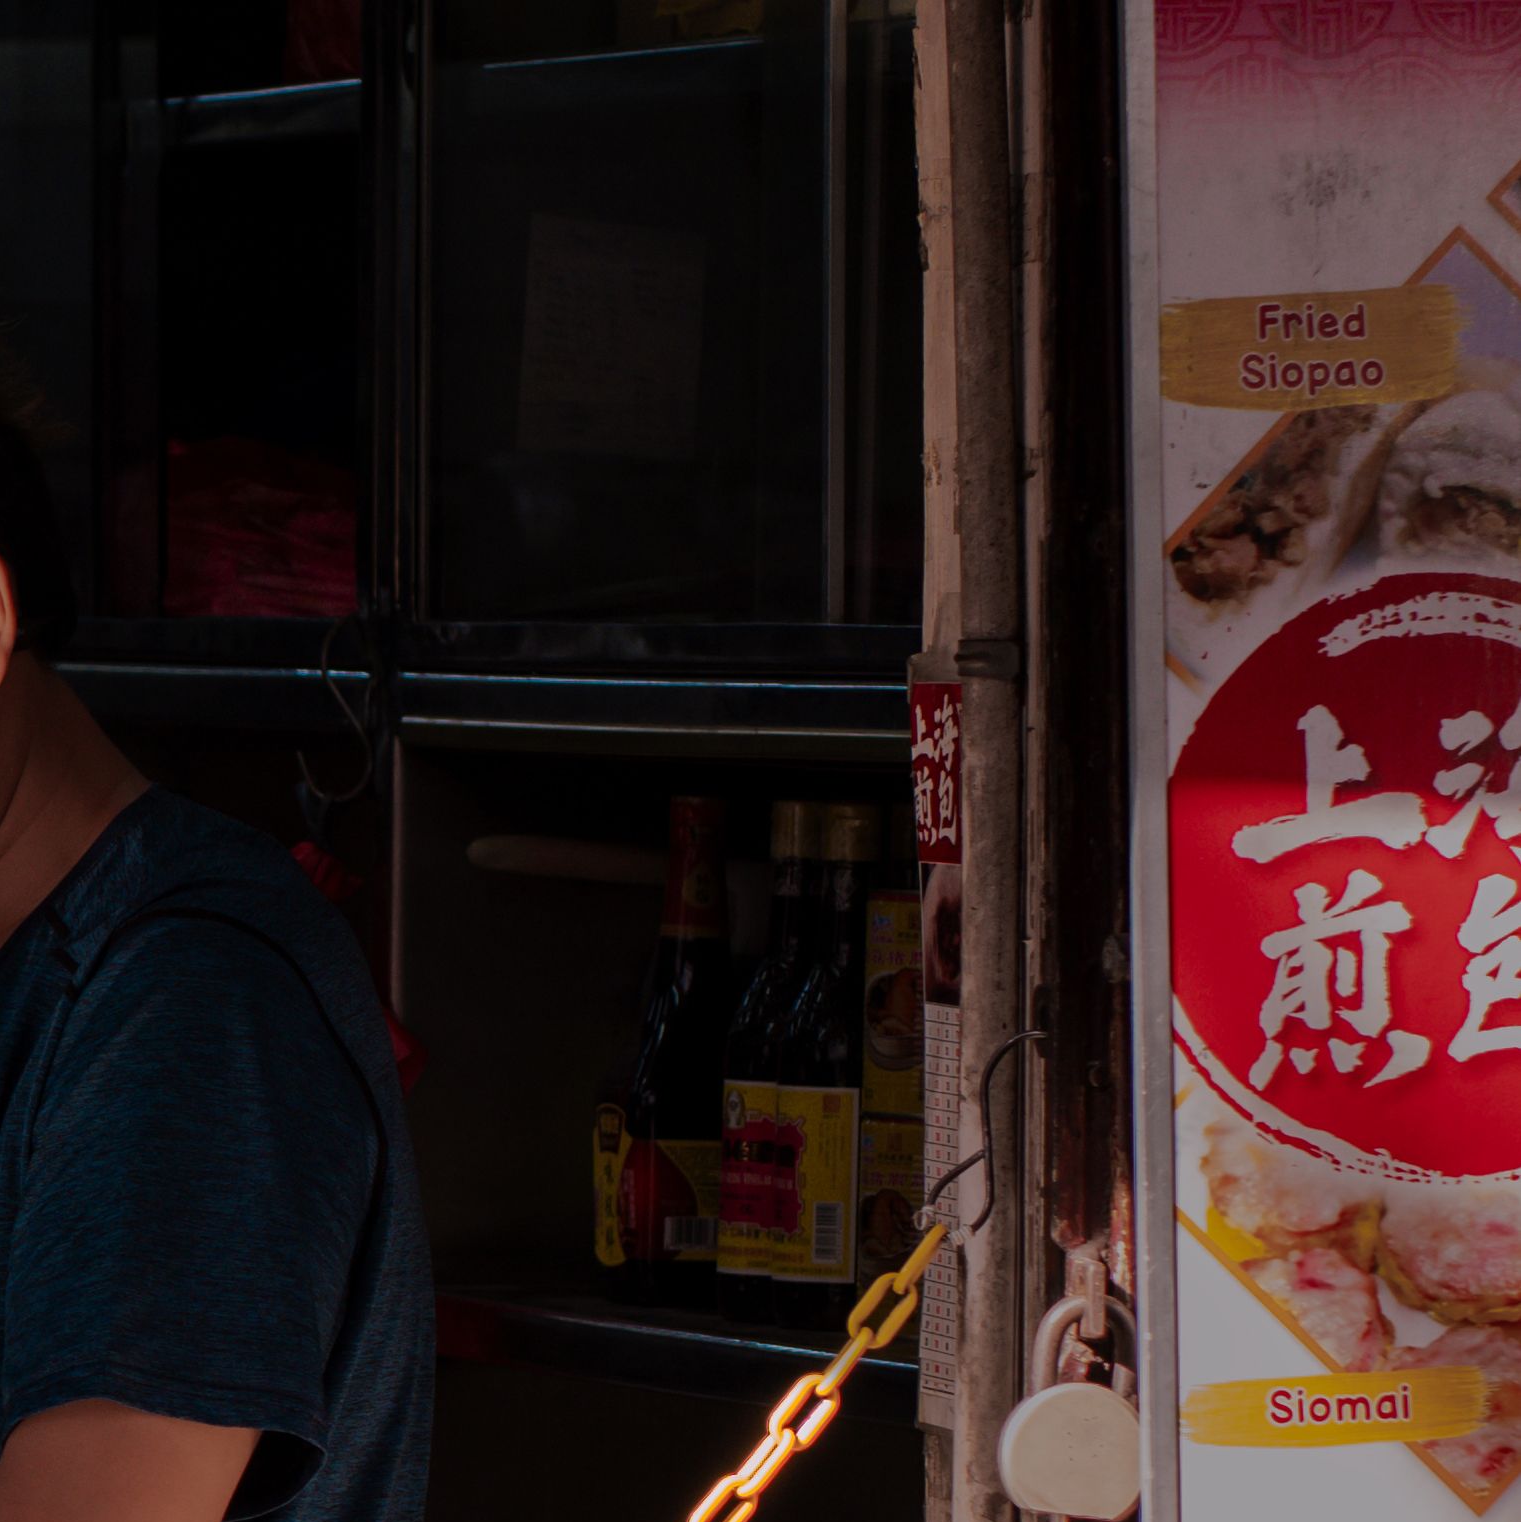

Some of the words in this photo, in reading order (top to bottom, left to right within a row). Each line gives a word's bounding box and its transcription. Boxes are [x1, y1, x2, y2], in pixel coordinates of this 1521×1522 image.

[1257, 303, 1366, 340] Fried
[1241, 354, 1384, 395] Siopao
[1269, 1385, 1410, 1424] Siomai
